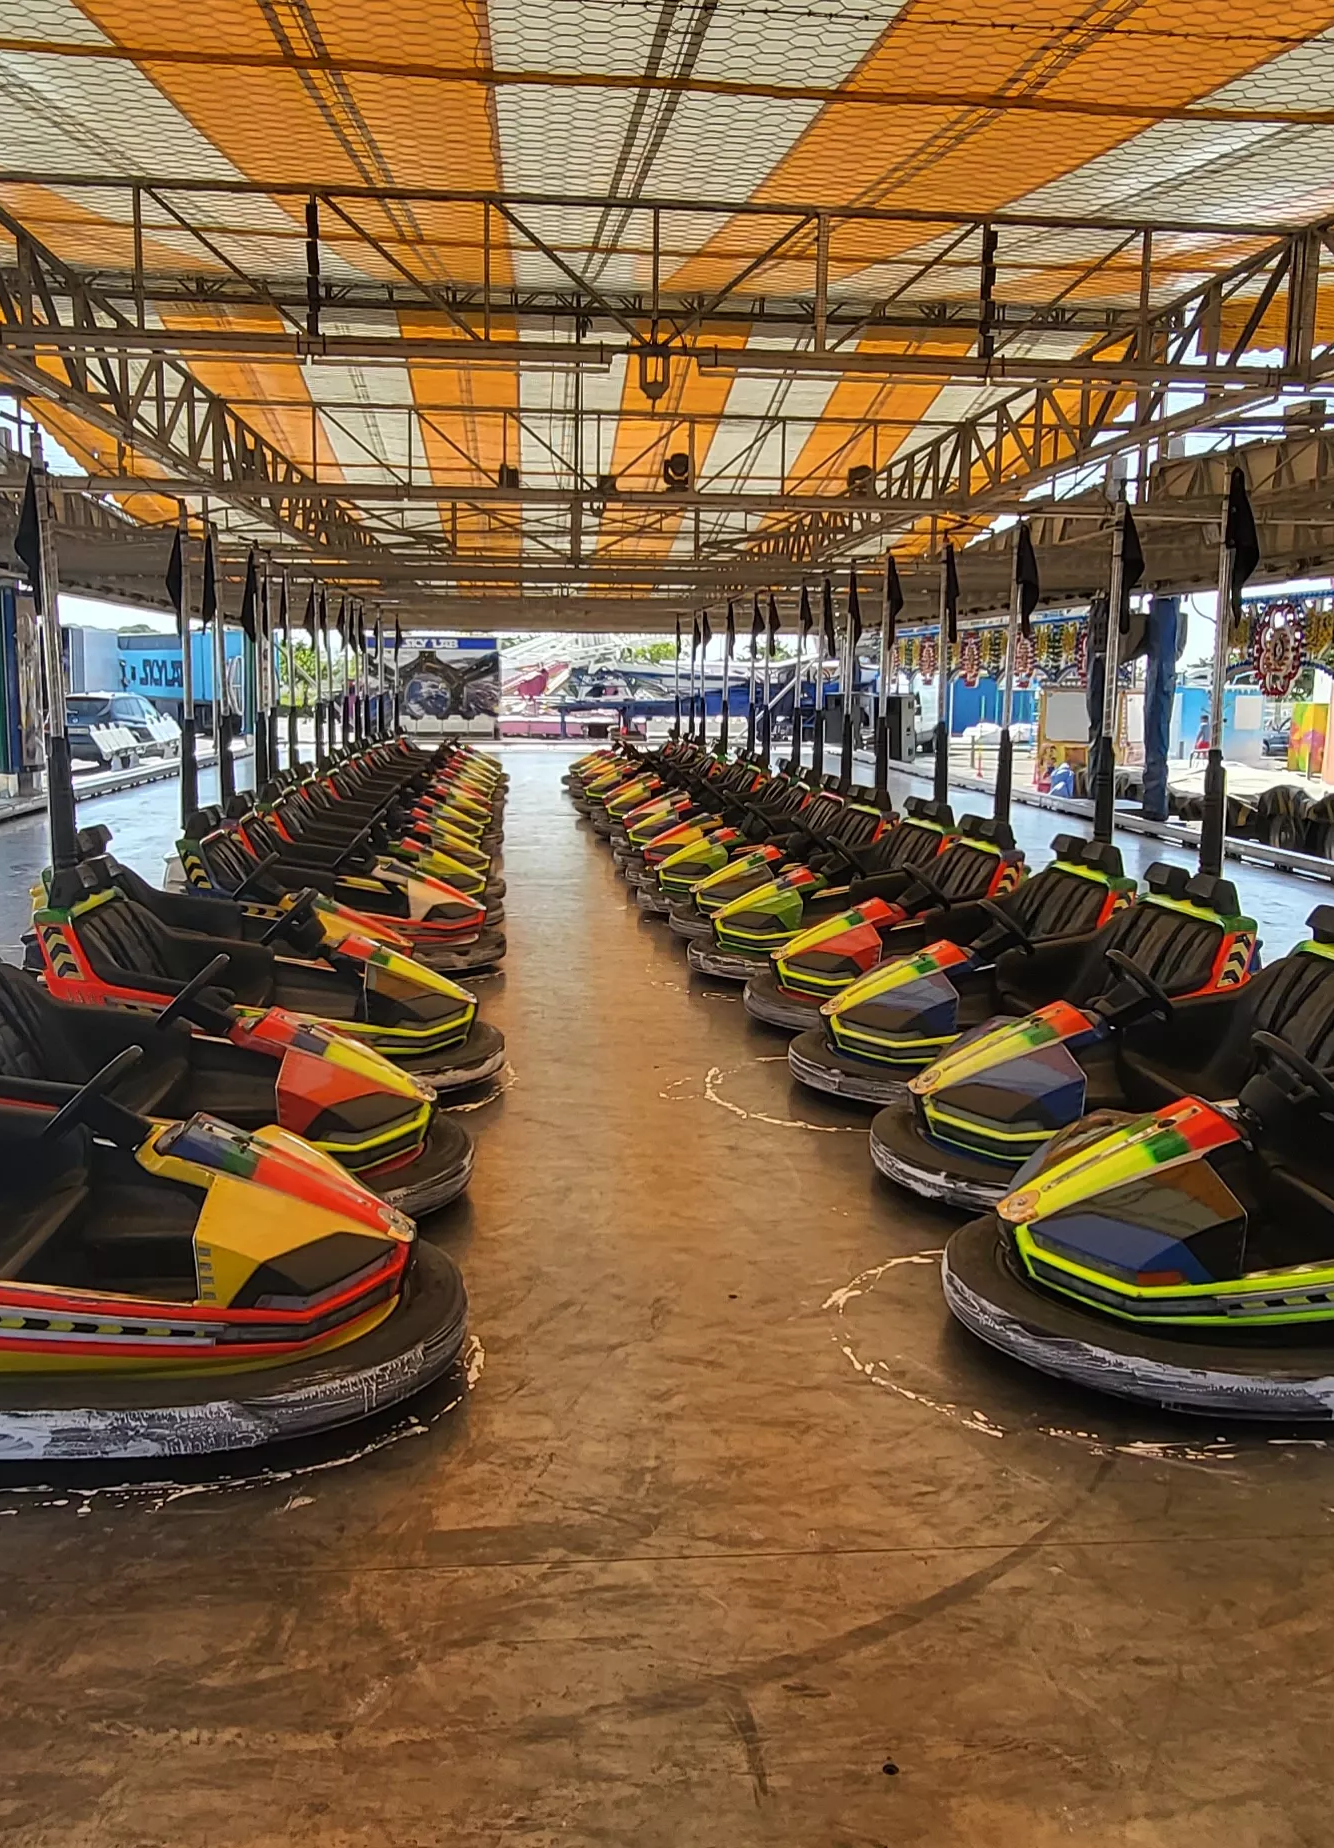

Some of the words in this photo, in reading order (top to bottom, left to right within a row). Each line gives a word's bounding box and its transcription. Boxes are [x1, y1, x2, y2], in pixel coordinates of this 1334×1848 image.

[401, 638, 427, 649] SKY
[431, 638, 459, 649] LAB
[139, 659, 184, 688] SKYLA
